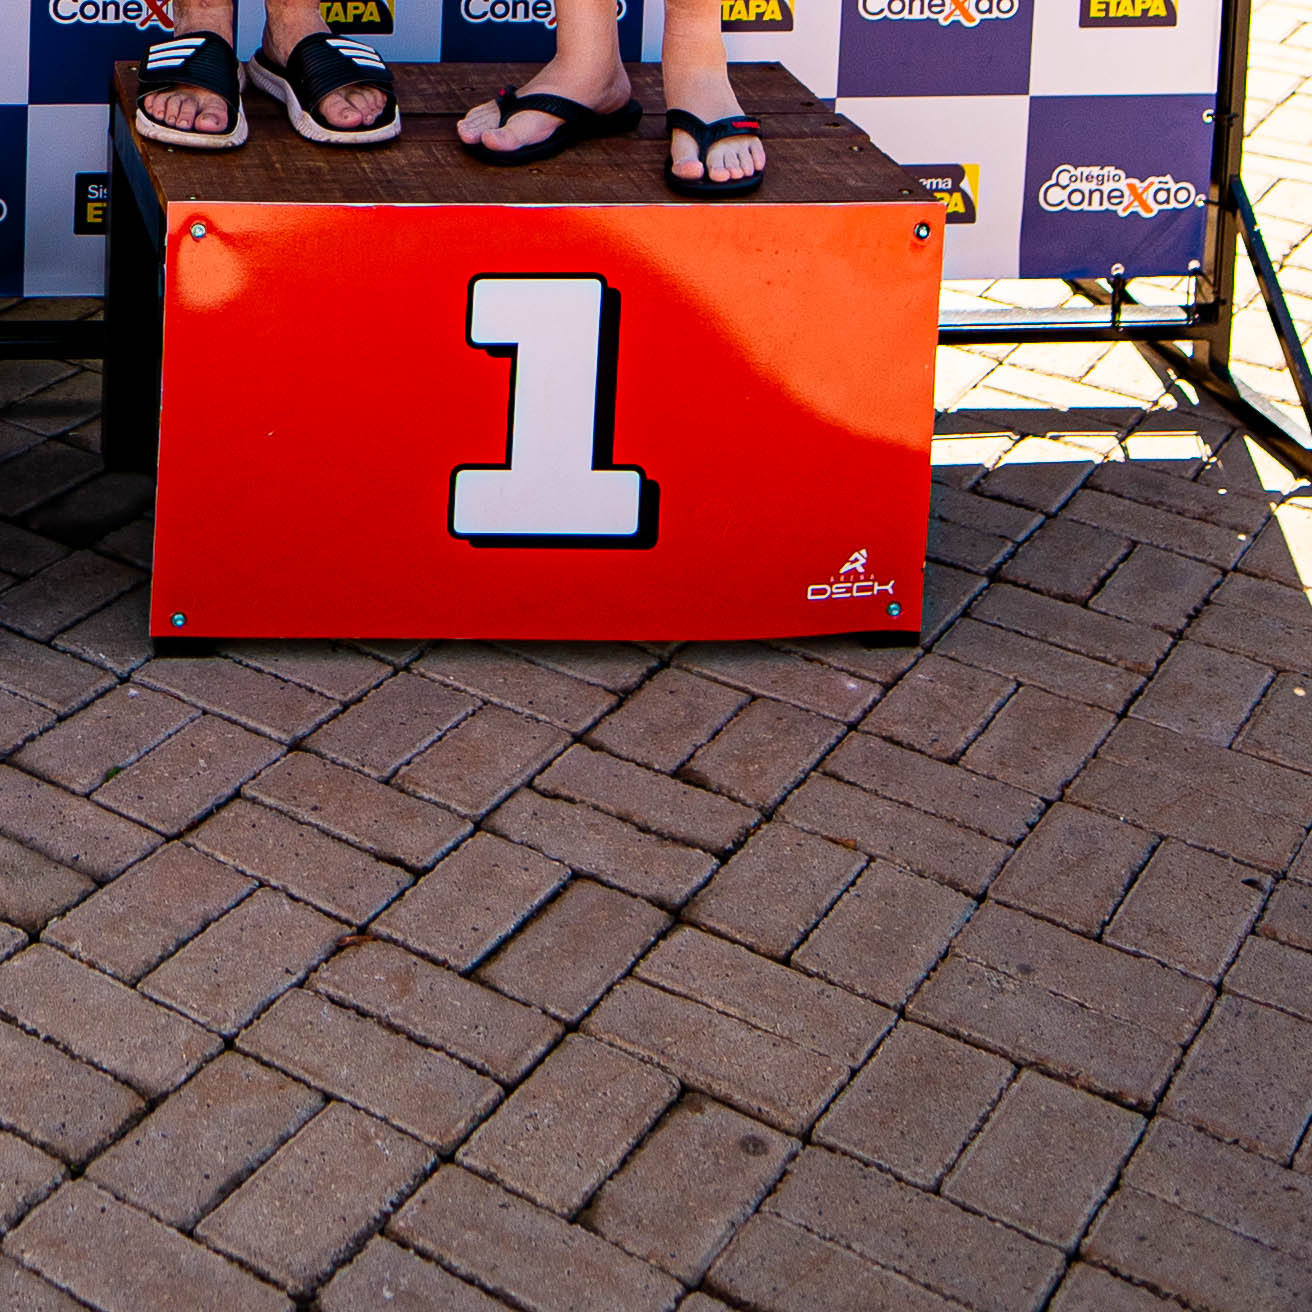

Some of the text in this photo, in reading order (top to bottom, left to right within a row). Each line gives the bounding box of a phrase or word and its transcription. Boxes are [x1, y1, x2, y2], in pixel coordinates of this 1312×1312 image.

[319, 0, 383, 23] TAPA
[1054, 166, 1120, 188] Colégio
[449, 274, 656, 545] 1
[807, 579, 895, 600] DECK
